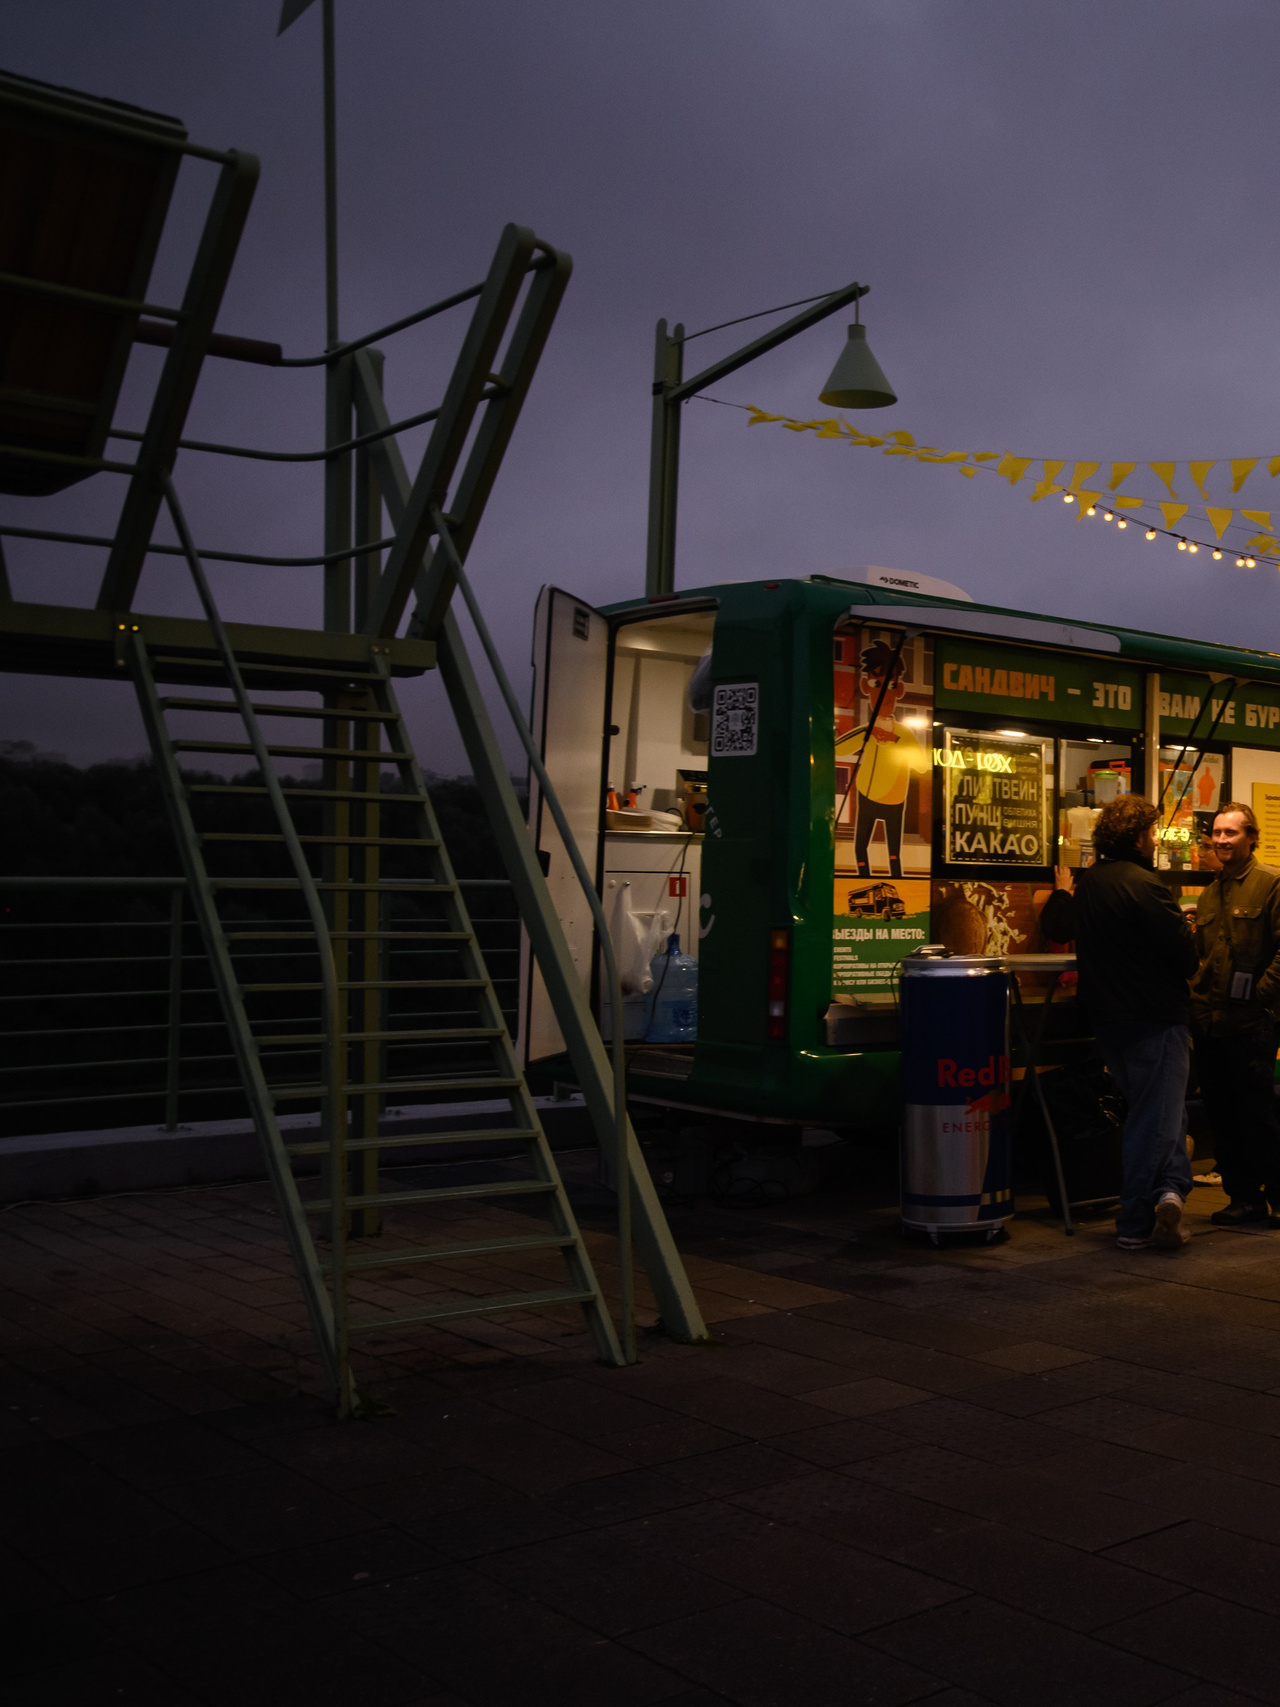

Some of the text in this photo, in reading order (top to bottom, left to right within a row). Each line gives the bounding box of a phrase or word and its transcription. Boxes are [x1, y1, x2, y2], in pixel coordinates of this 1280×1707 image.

[889, 577, 920, 589] DOMETIC
[943, 662, 1056, 702] САНДВИЧ
[1092, 681, 1133, 711] ЭТО
[1159, 691, 1201, 720] ВАМ
[1211, 698, 1236, 725] НЕ
[955, 831, 1039, 856] КАКАО
[875, 928, 890, 940] НА
[890, 928, 926, 940] МЕСТО:
[936, 1053, 995, 1089] Red
